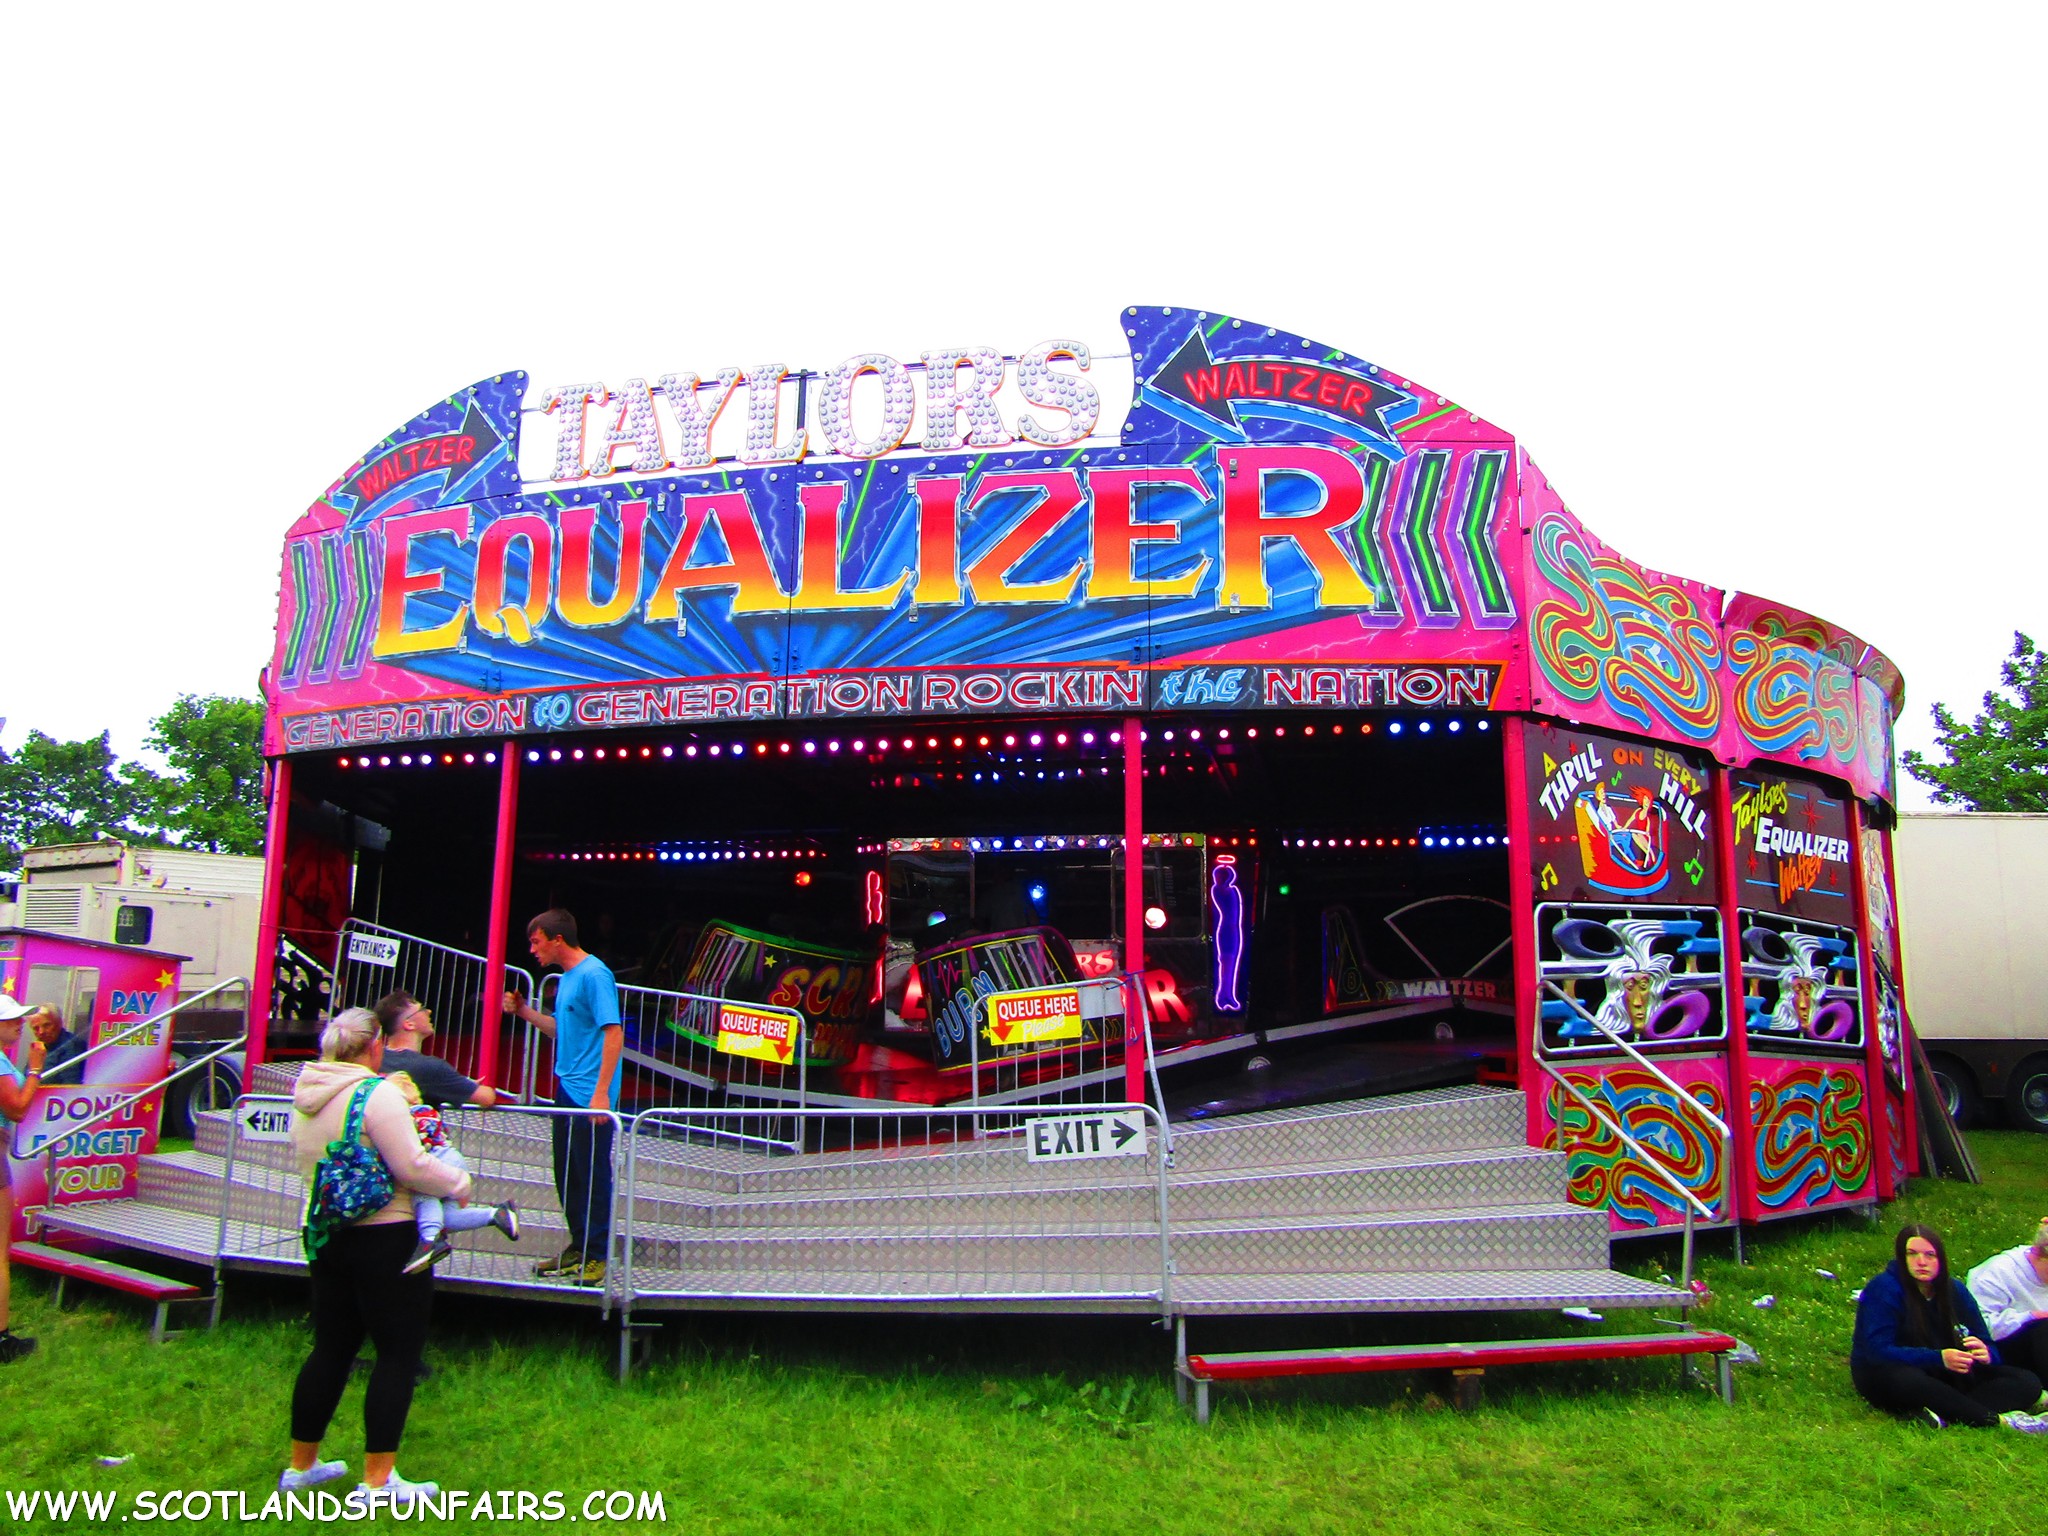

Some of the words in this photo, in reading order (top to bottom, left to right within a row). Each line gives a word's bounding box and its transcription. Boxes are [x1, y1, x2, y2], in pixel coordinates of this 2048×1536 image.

[1184, 362, 1374, 417] WALTZER
[541, 339, 1100, 482] TAYLORS
[357, 435, 476, 500] WALTZER
[371, 443, 1379, 660] EQUALIZER
[284, 696, 528, 747] GENERATION
[532, 692, 571, 727] to
[576, 675, 913, 726] GENERATION
[921, 670, 1142, 710] ROCKIN
[1160, 667, 1247, 705] the
[1263, 668, 1489, 706] NATION
[1543, 751, 1558, 778] A
[1612, 747, 1645, 767] ON
[1653, 747, 1702, 796] EVERY
[1539, 742, 1603, 821] THRILL
[1659, 772, 1707, 840] HILL
[350, 938, 387, 959] ENTRANCE
[110, 990, 159, 1015] PAY
[1402, 979, 1497, 998] WALTZER
[998, 999, 1043, 1020] QUEUE
[1043, 995, 1077, 1015] HERE
[98, 1021, 161, 1047] HERE
[721, 1011, 759, 1033] QUEUE
[759, 1018, 788, 1039] HERE
[1021, 1012, 1066, 1041] Please
[1033, 1118, 1104, 1157] EXIT
